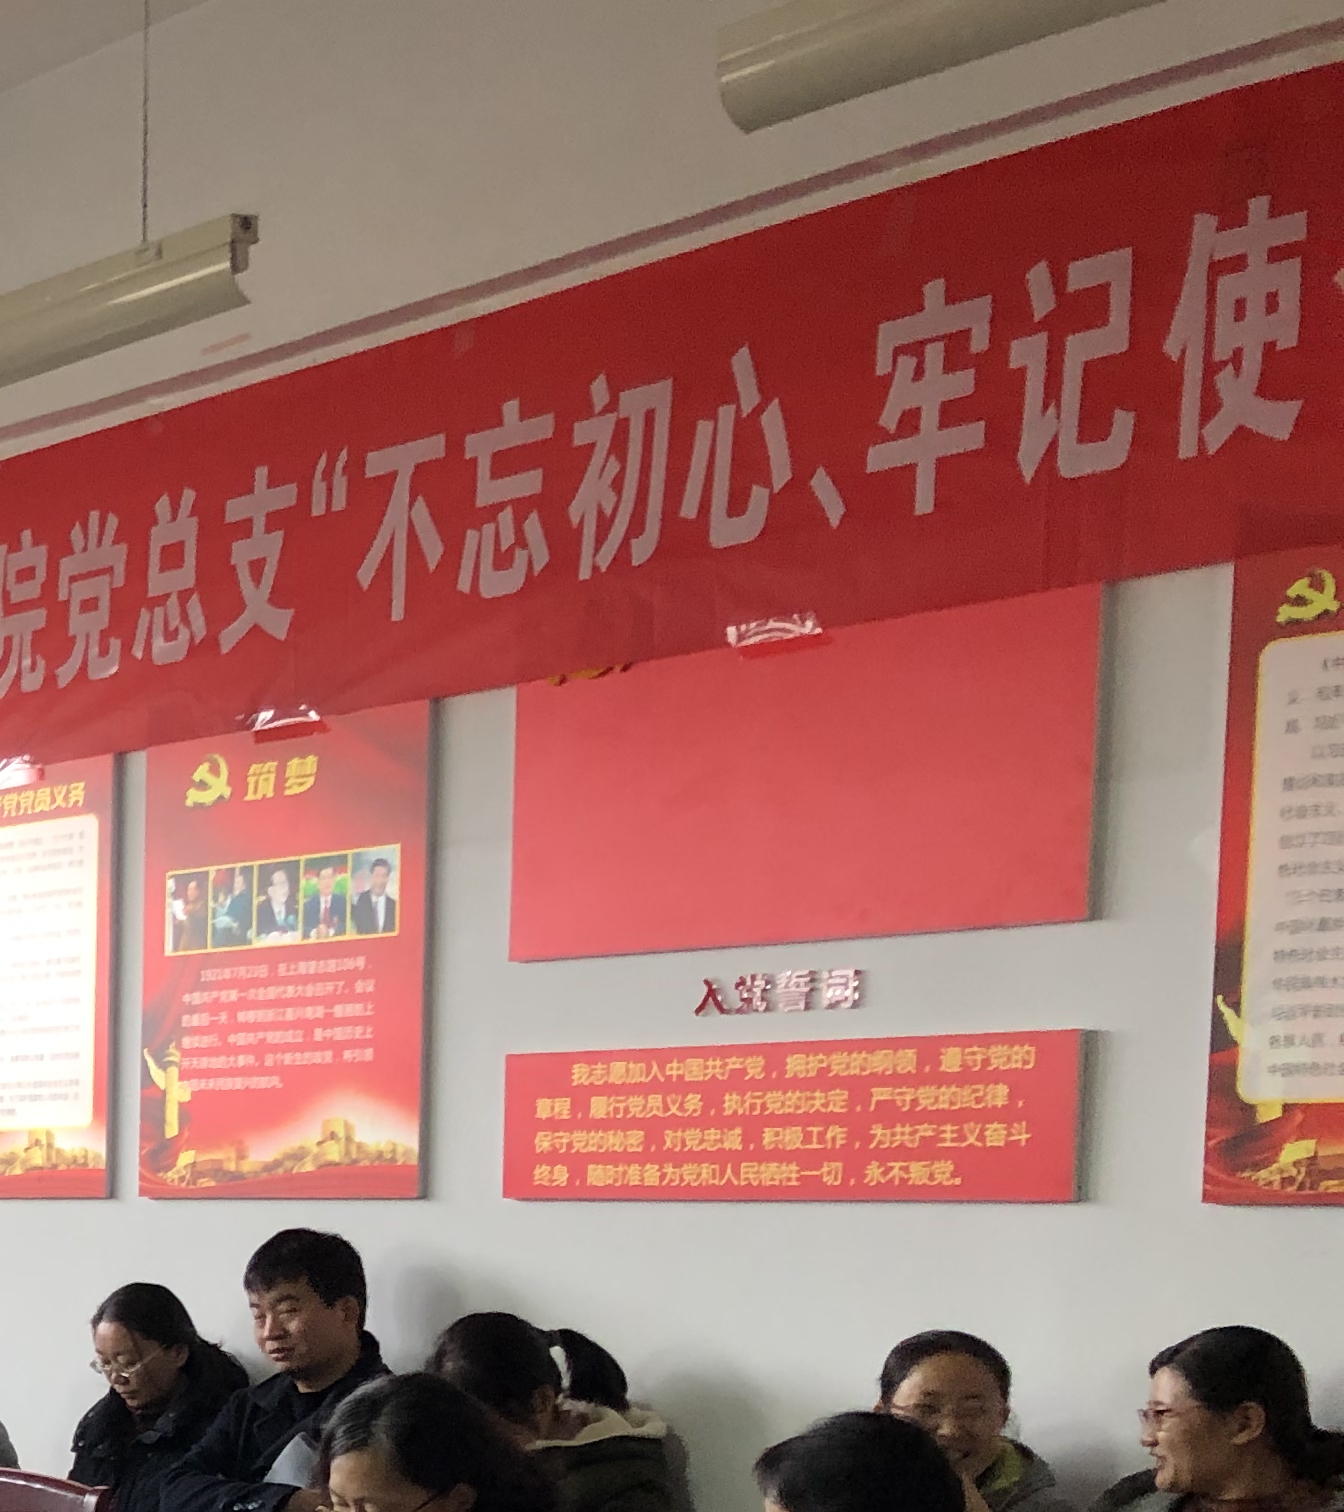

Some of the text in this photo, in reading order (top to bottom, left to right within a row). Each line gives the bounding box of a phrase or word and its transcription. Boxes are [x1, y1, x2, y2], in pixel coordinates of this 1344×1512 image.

[244, 755, 319, 801] 筑梦
[694, 968, 863, 1017] 入党誓词
[571, 1043, 1036, 1086] 我志愿加入中国共产党，拥护党的纲领，遵守党的
[535, 1083, 1026, 1119] 章程，履行党员义务，执行党的决定，严守党的纪律，
[534, 1121, 1031, 1153] 保守党的秘密，对党忠诚，积极工作，为共产主义奋斗
[533, 1160, 962, 1187] 终身，随时准备为党和人民牺牲一切，永不叛党。
